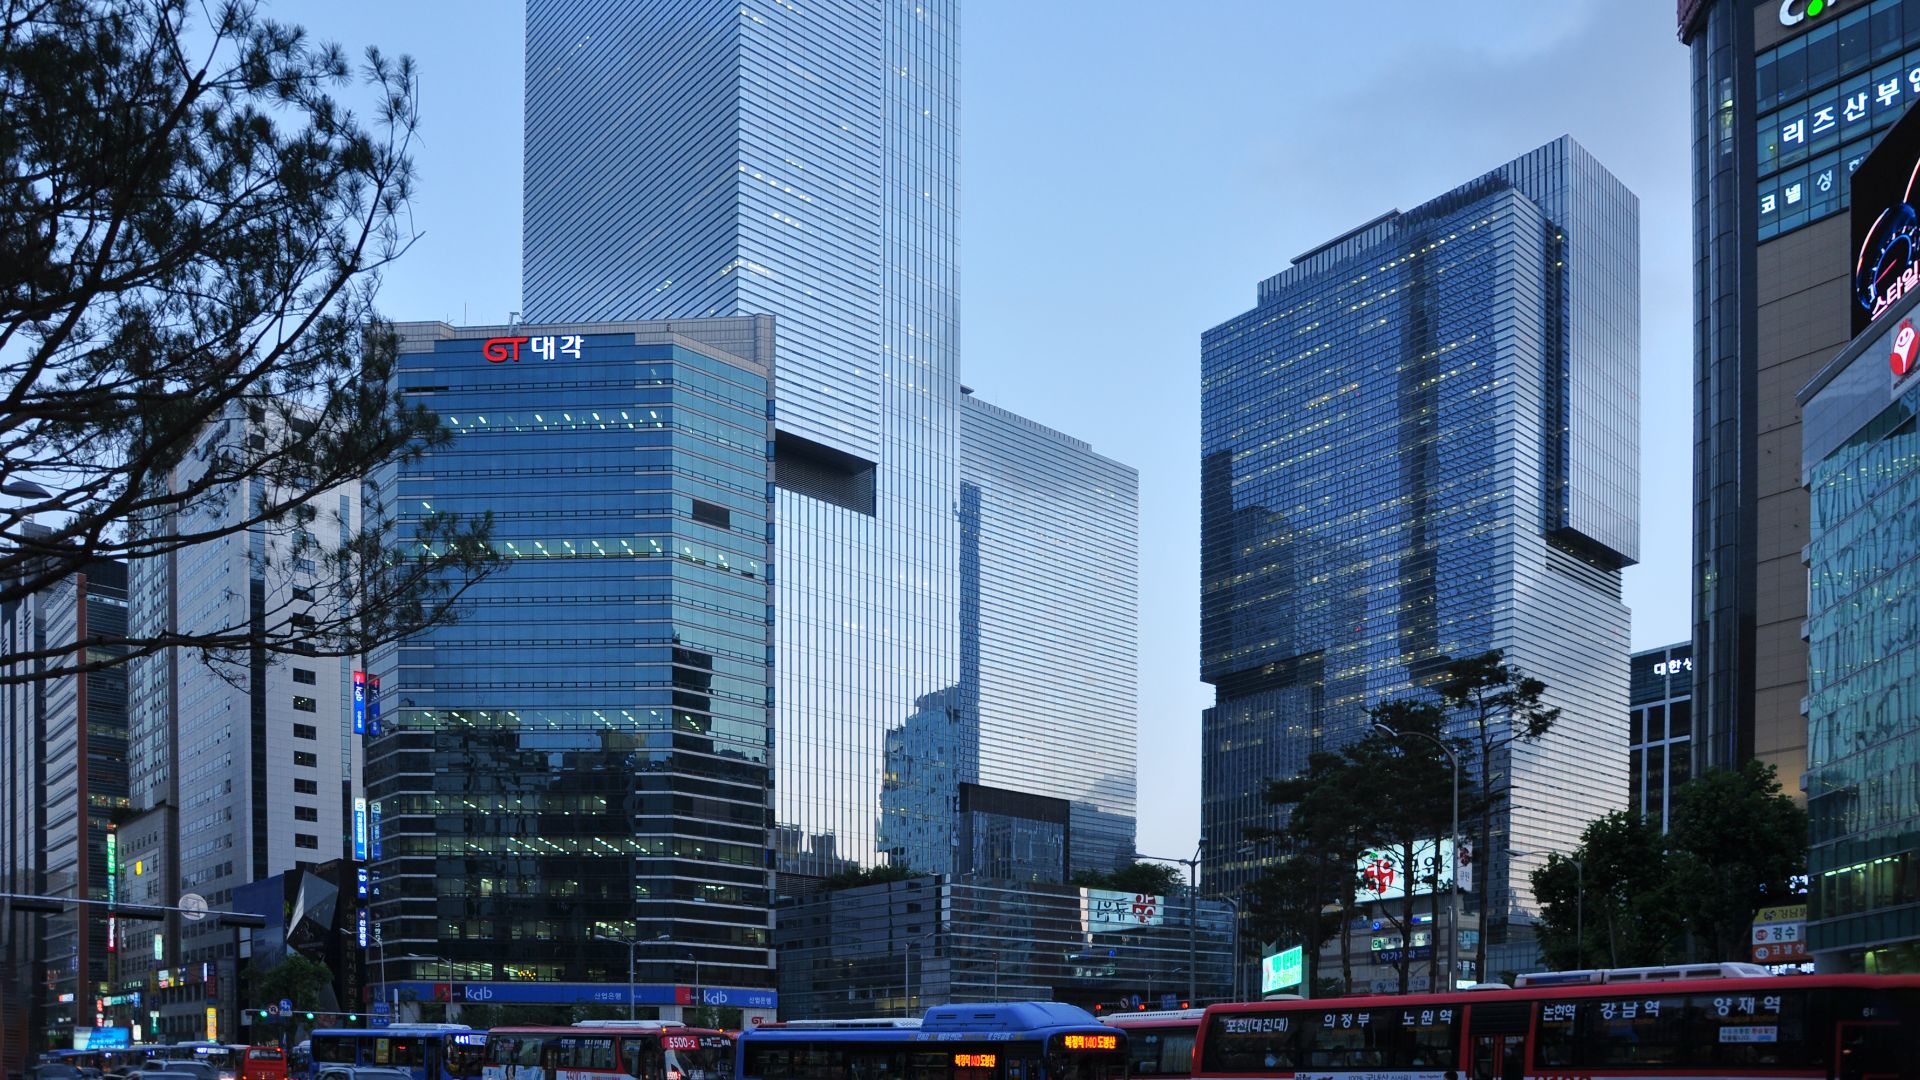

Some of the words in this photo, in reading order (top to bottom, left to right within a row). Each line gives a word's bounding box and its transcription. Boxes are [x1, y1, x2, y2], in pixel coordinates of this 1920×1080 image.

[531, 335, 585, 361] 대각
[465, 986, 492, 1001] kdb
[703, 989, 728, 1005] kdb
[1542, 1003, 1577, 1022] 논현역
[1600, 1000, 1660, 1020] 강남역
[1713, 995, 1781, 1017] 양재역
[1226, 1017, 1289, 1033] 포천(대진대)
[1323, 1012, 1371, 1028] 의정부
[1402, 1009, 1453, 1026] 노원역
[455, 1035, 469, 1045] 441
[669, 1037, 696, 1048] 5500-2
[1085, 1036, 1097, 1049] 140
[1098, 1035, 1116, 1049] 도봉산
